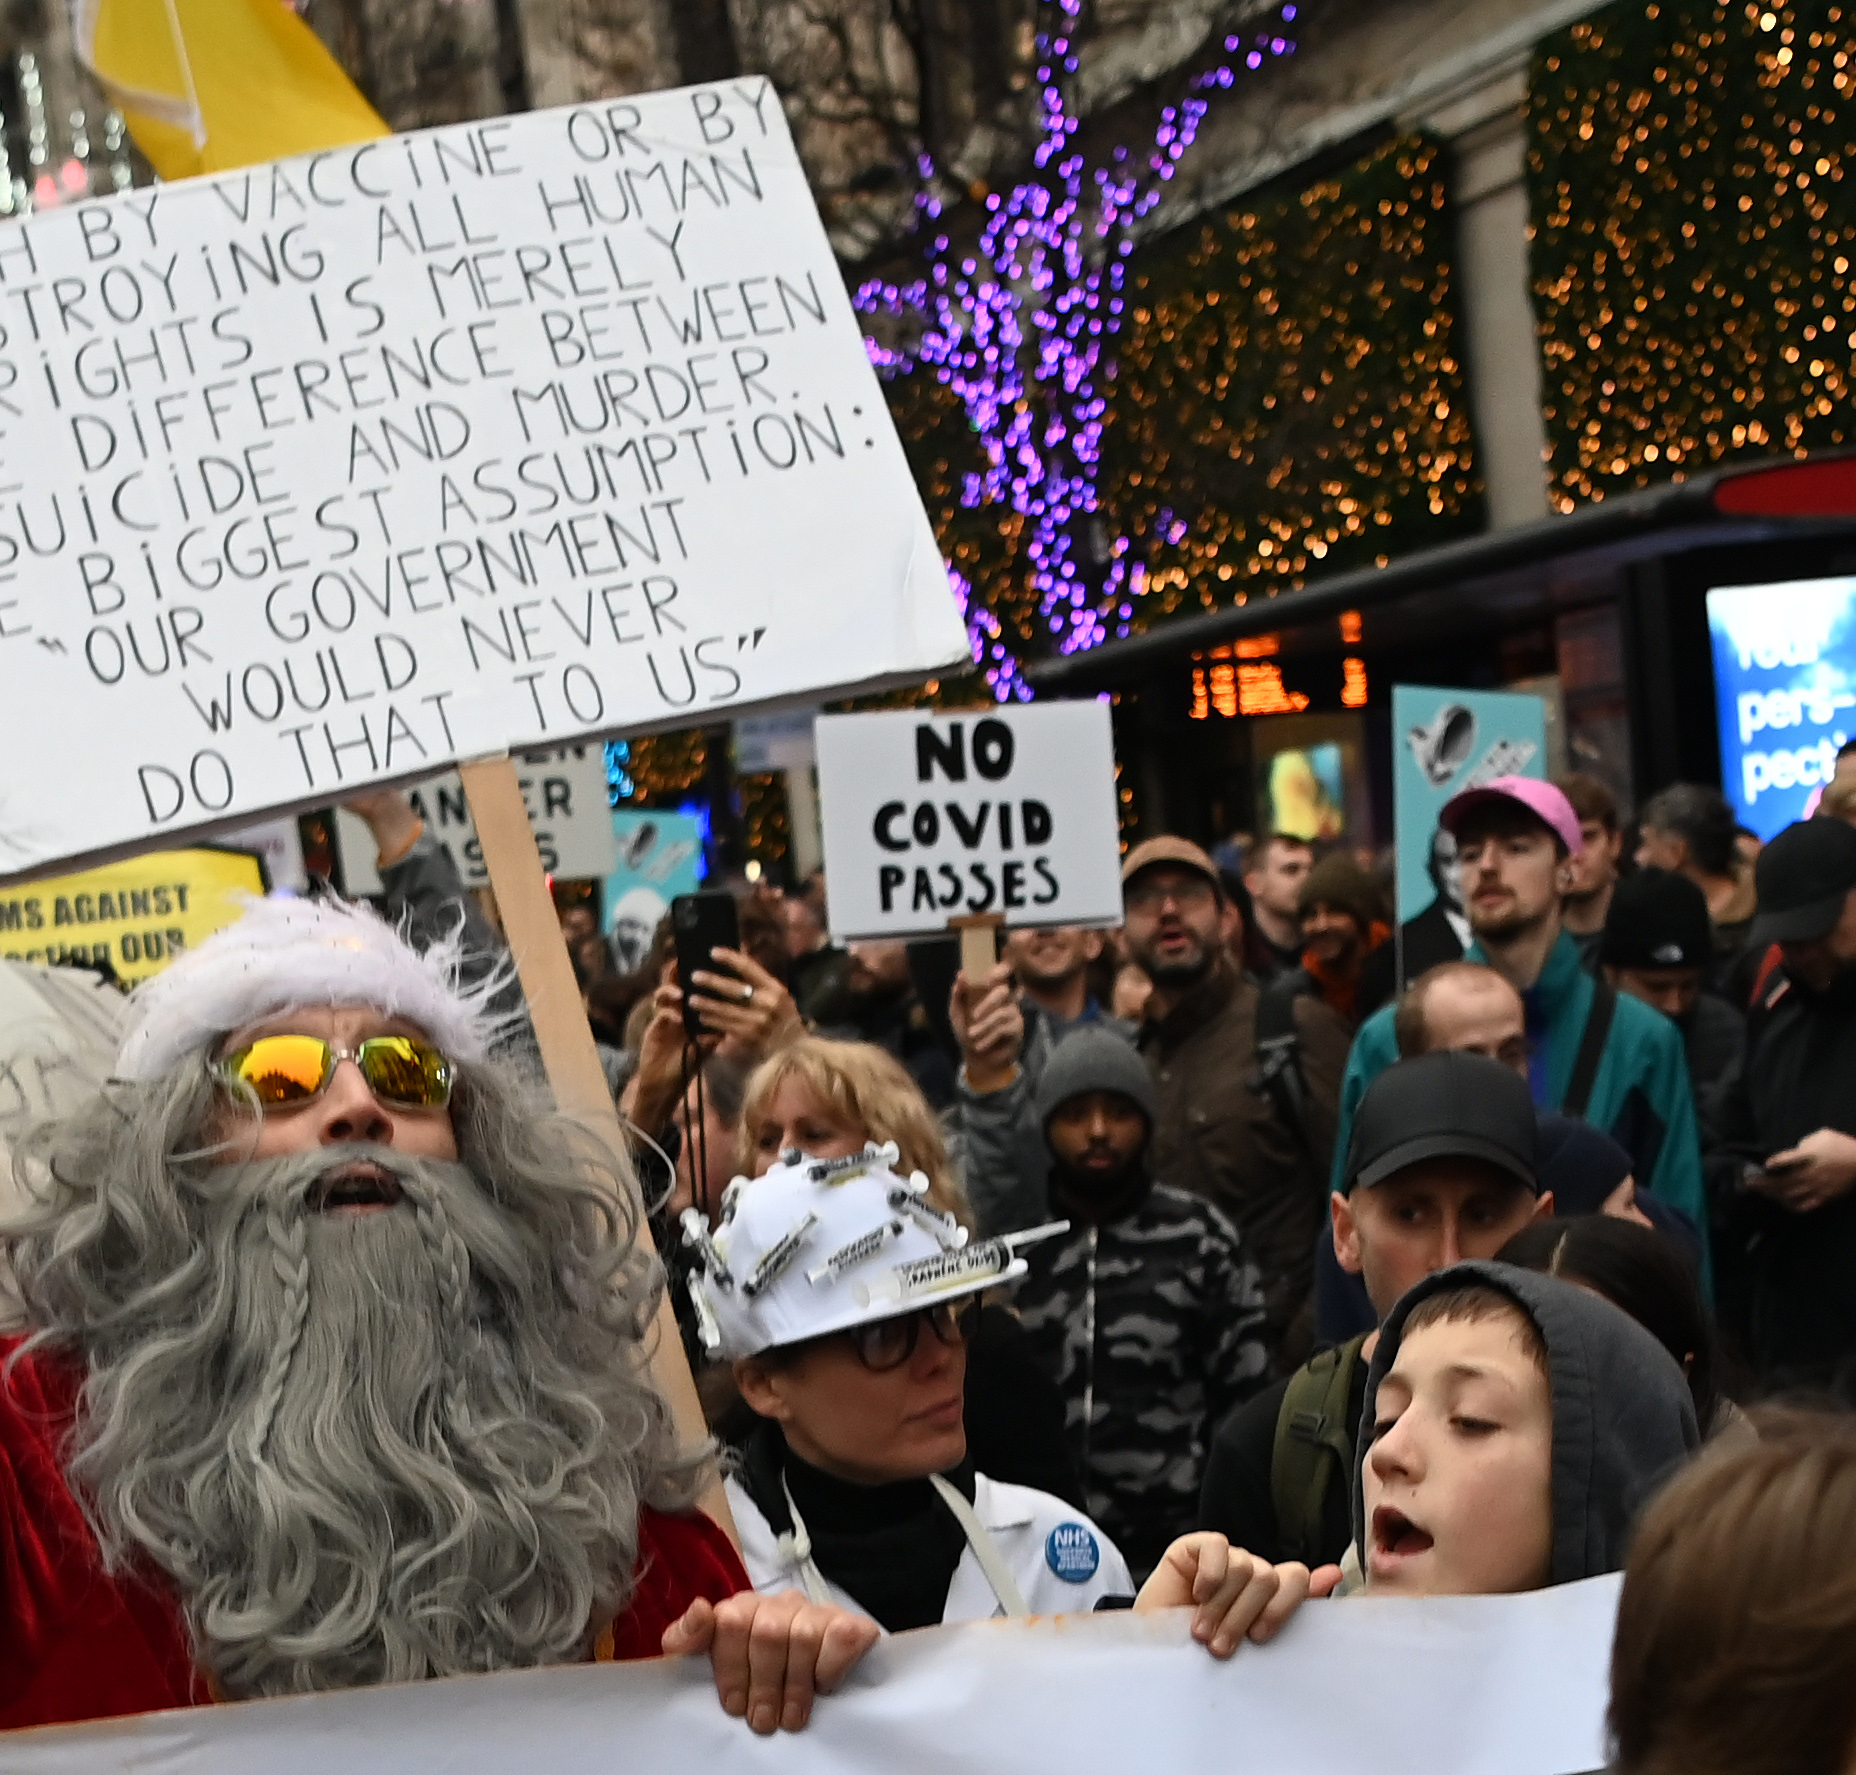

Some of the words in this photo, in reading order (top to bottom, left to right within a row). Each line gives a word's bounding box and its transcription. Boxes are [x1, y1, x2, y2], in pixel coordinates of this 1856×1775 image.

[78, 194, 161, 262] BY
[567, 104, 652, 163] OR
[691, 81, 770, 147] BY
[377, 193, 499, 264] ALL
[538, 148, 764, 232] HUMAN
[310, 275, 387, 345] IS
[427, 219, 687, 319] MERELY
[541, 271, 828, 372] BETWEEN
[348, 402, 471, 485] AND
[513, 347, 800, 445] MURDER.
[265, 498, 689, 645] GOVERNMENT
[182, 633, 416, 733] WOULD
[461, 576, 687, 672] NEVER
[137, 749, 233, 824] DO
[278, 692, 456, 788] THAT
[513, 664, 604, 731] TO
[915, 717, 1016, 783] NO
[873, 800, 1052, 851] COVID
[55, 883, 189, 927] AGAINST
[878, 857, 1060, 914] PASSES
[1055, 1528, 1090, 1547] NHS
